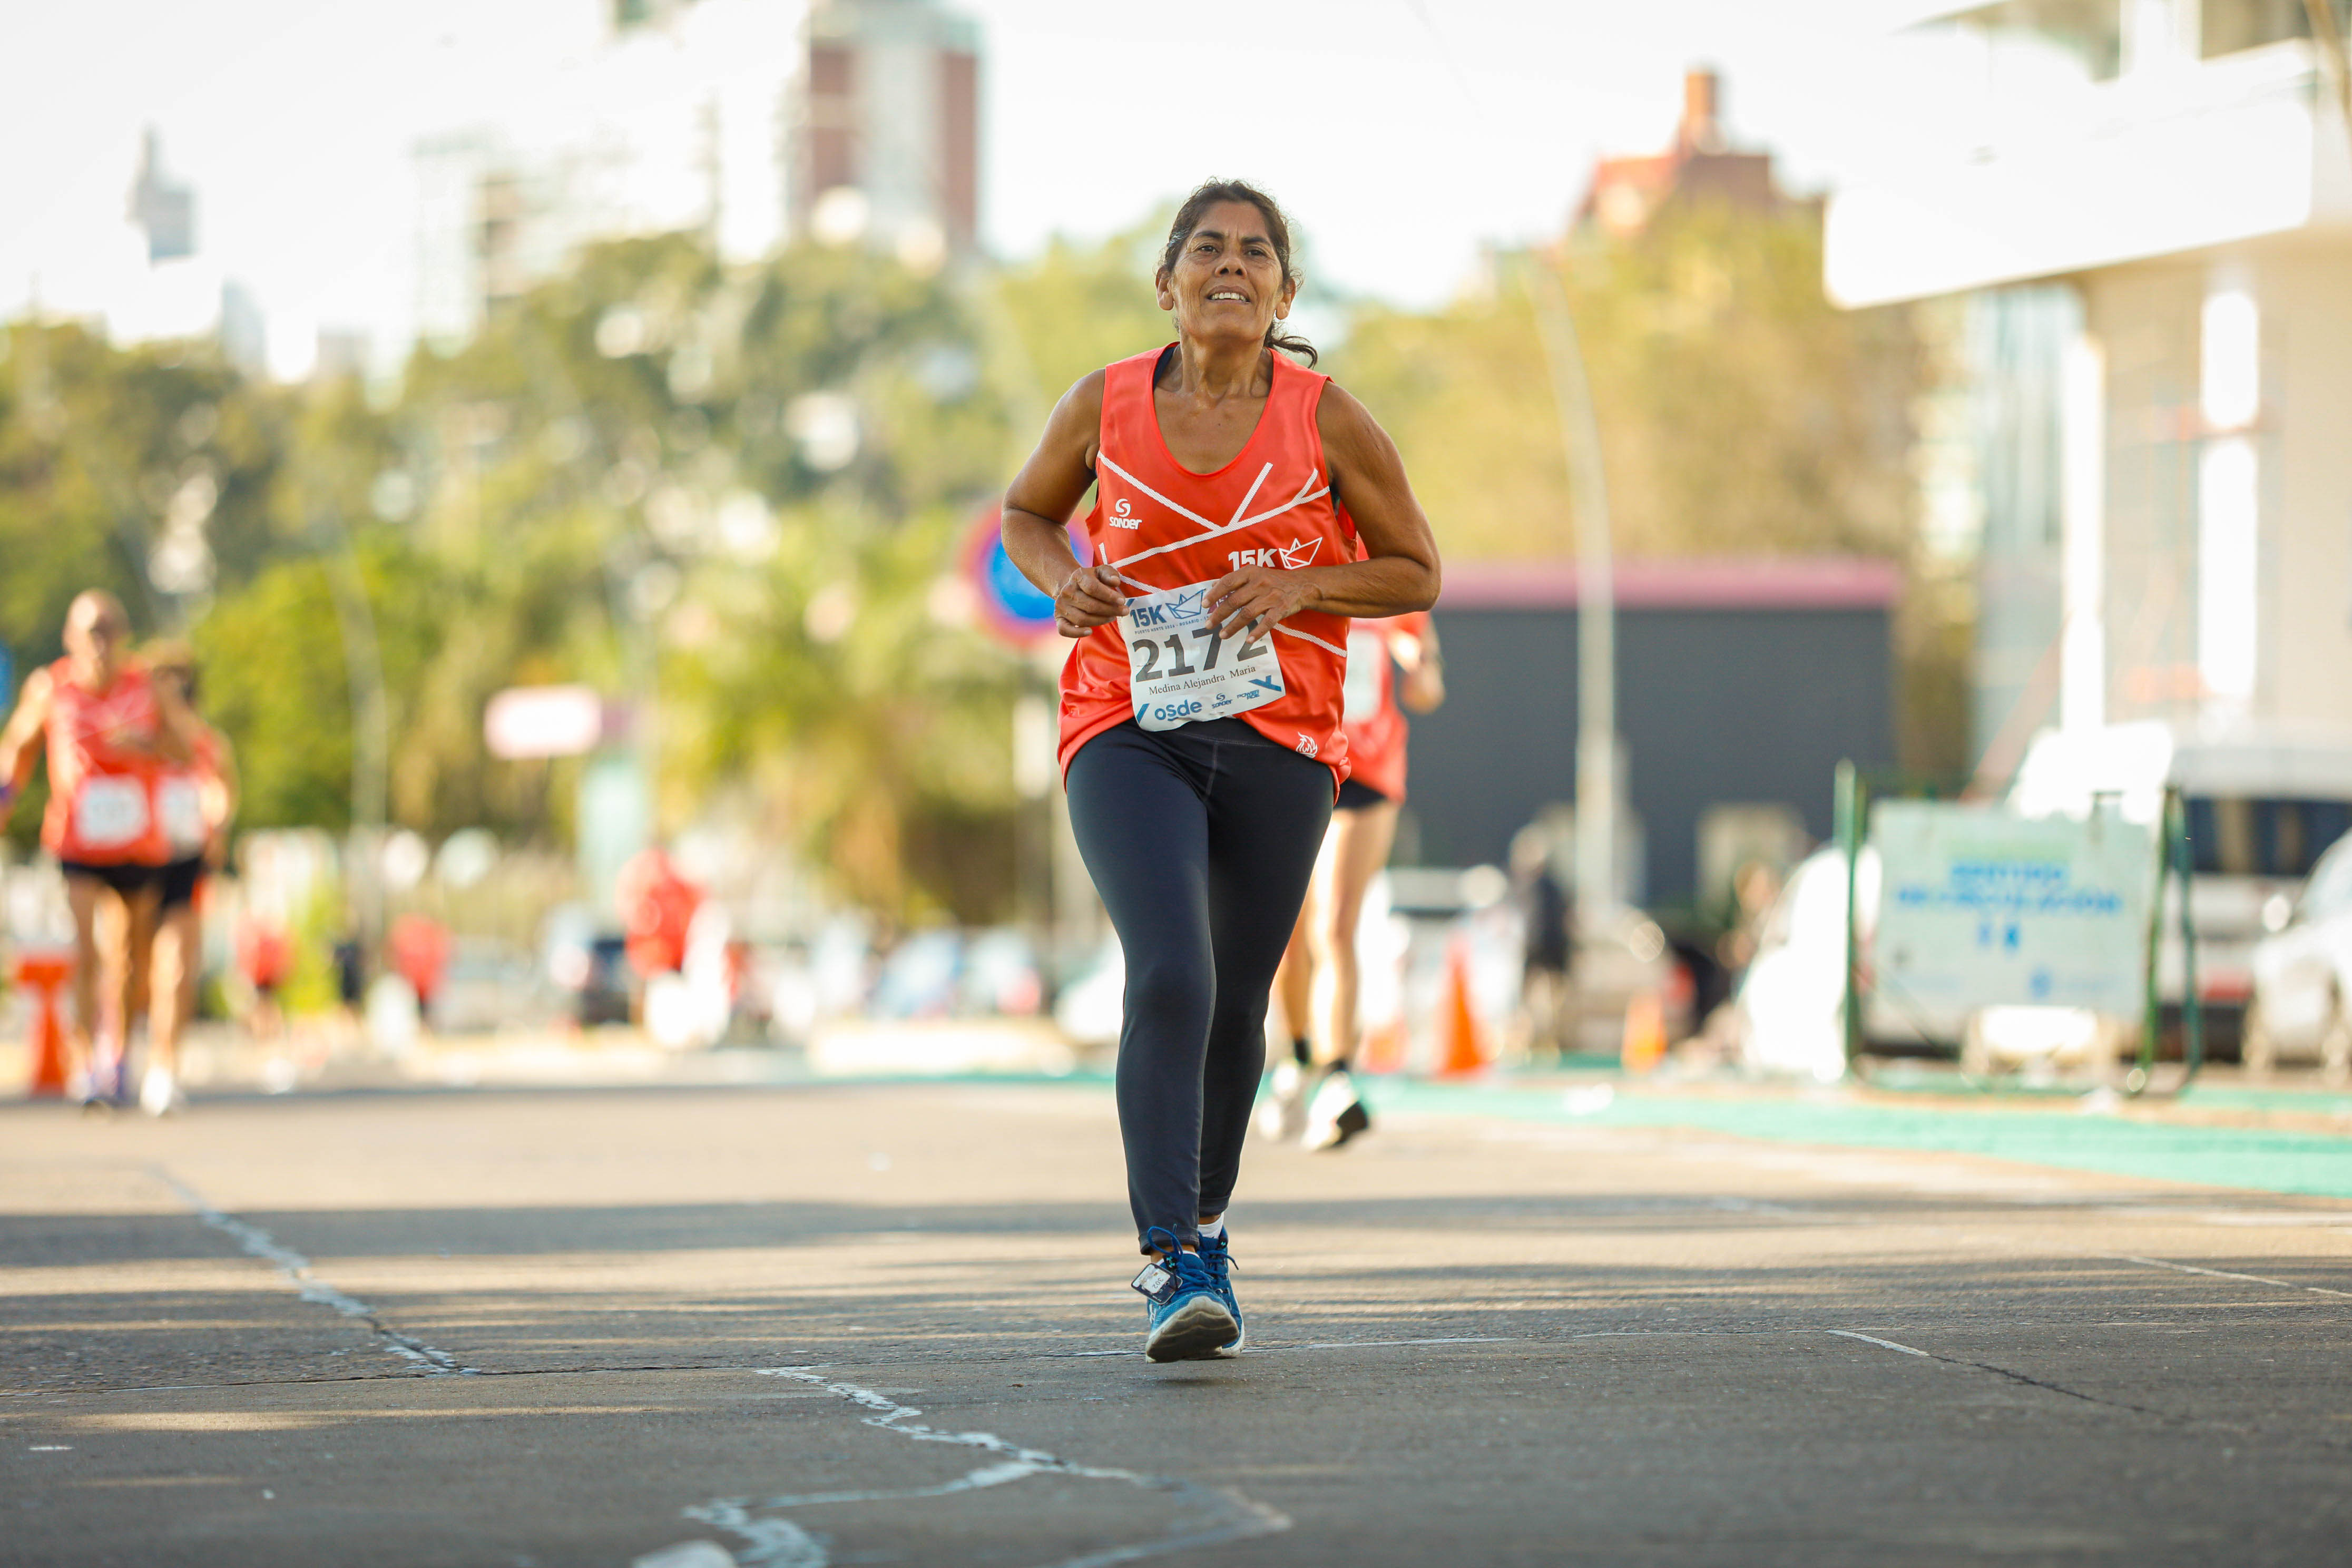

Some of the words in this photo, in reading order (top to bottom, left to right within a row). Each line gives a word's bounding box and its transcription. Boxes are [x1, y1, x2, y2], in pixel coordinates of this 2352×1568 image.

[1228, 548, 1278, 572] 15K
[1130, 604, 1167, 628] 15K
[1132, 619, 1268, 682] 2172
[1149, 683, 1181, 695] Medina
[1183, 674, 1226, 689] Alejandra
[1230, 665, 1256, 678] Maria
[1237, 689, 1259, 699] POWER
[1154, 699, 1202, 721] osde
[1152, 1278, 1164, 1289] 302
